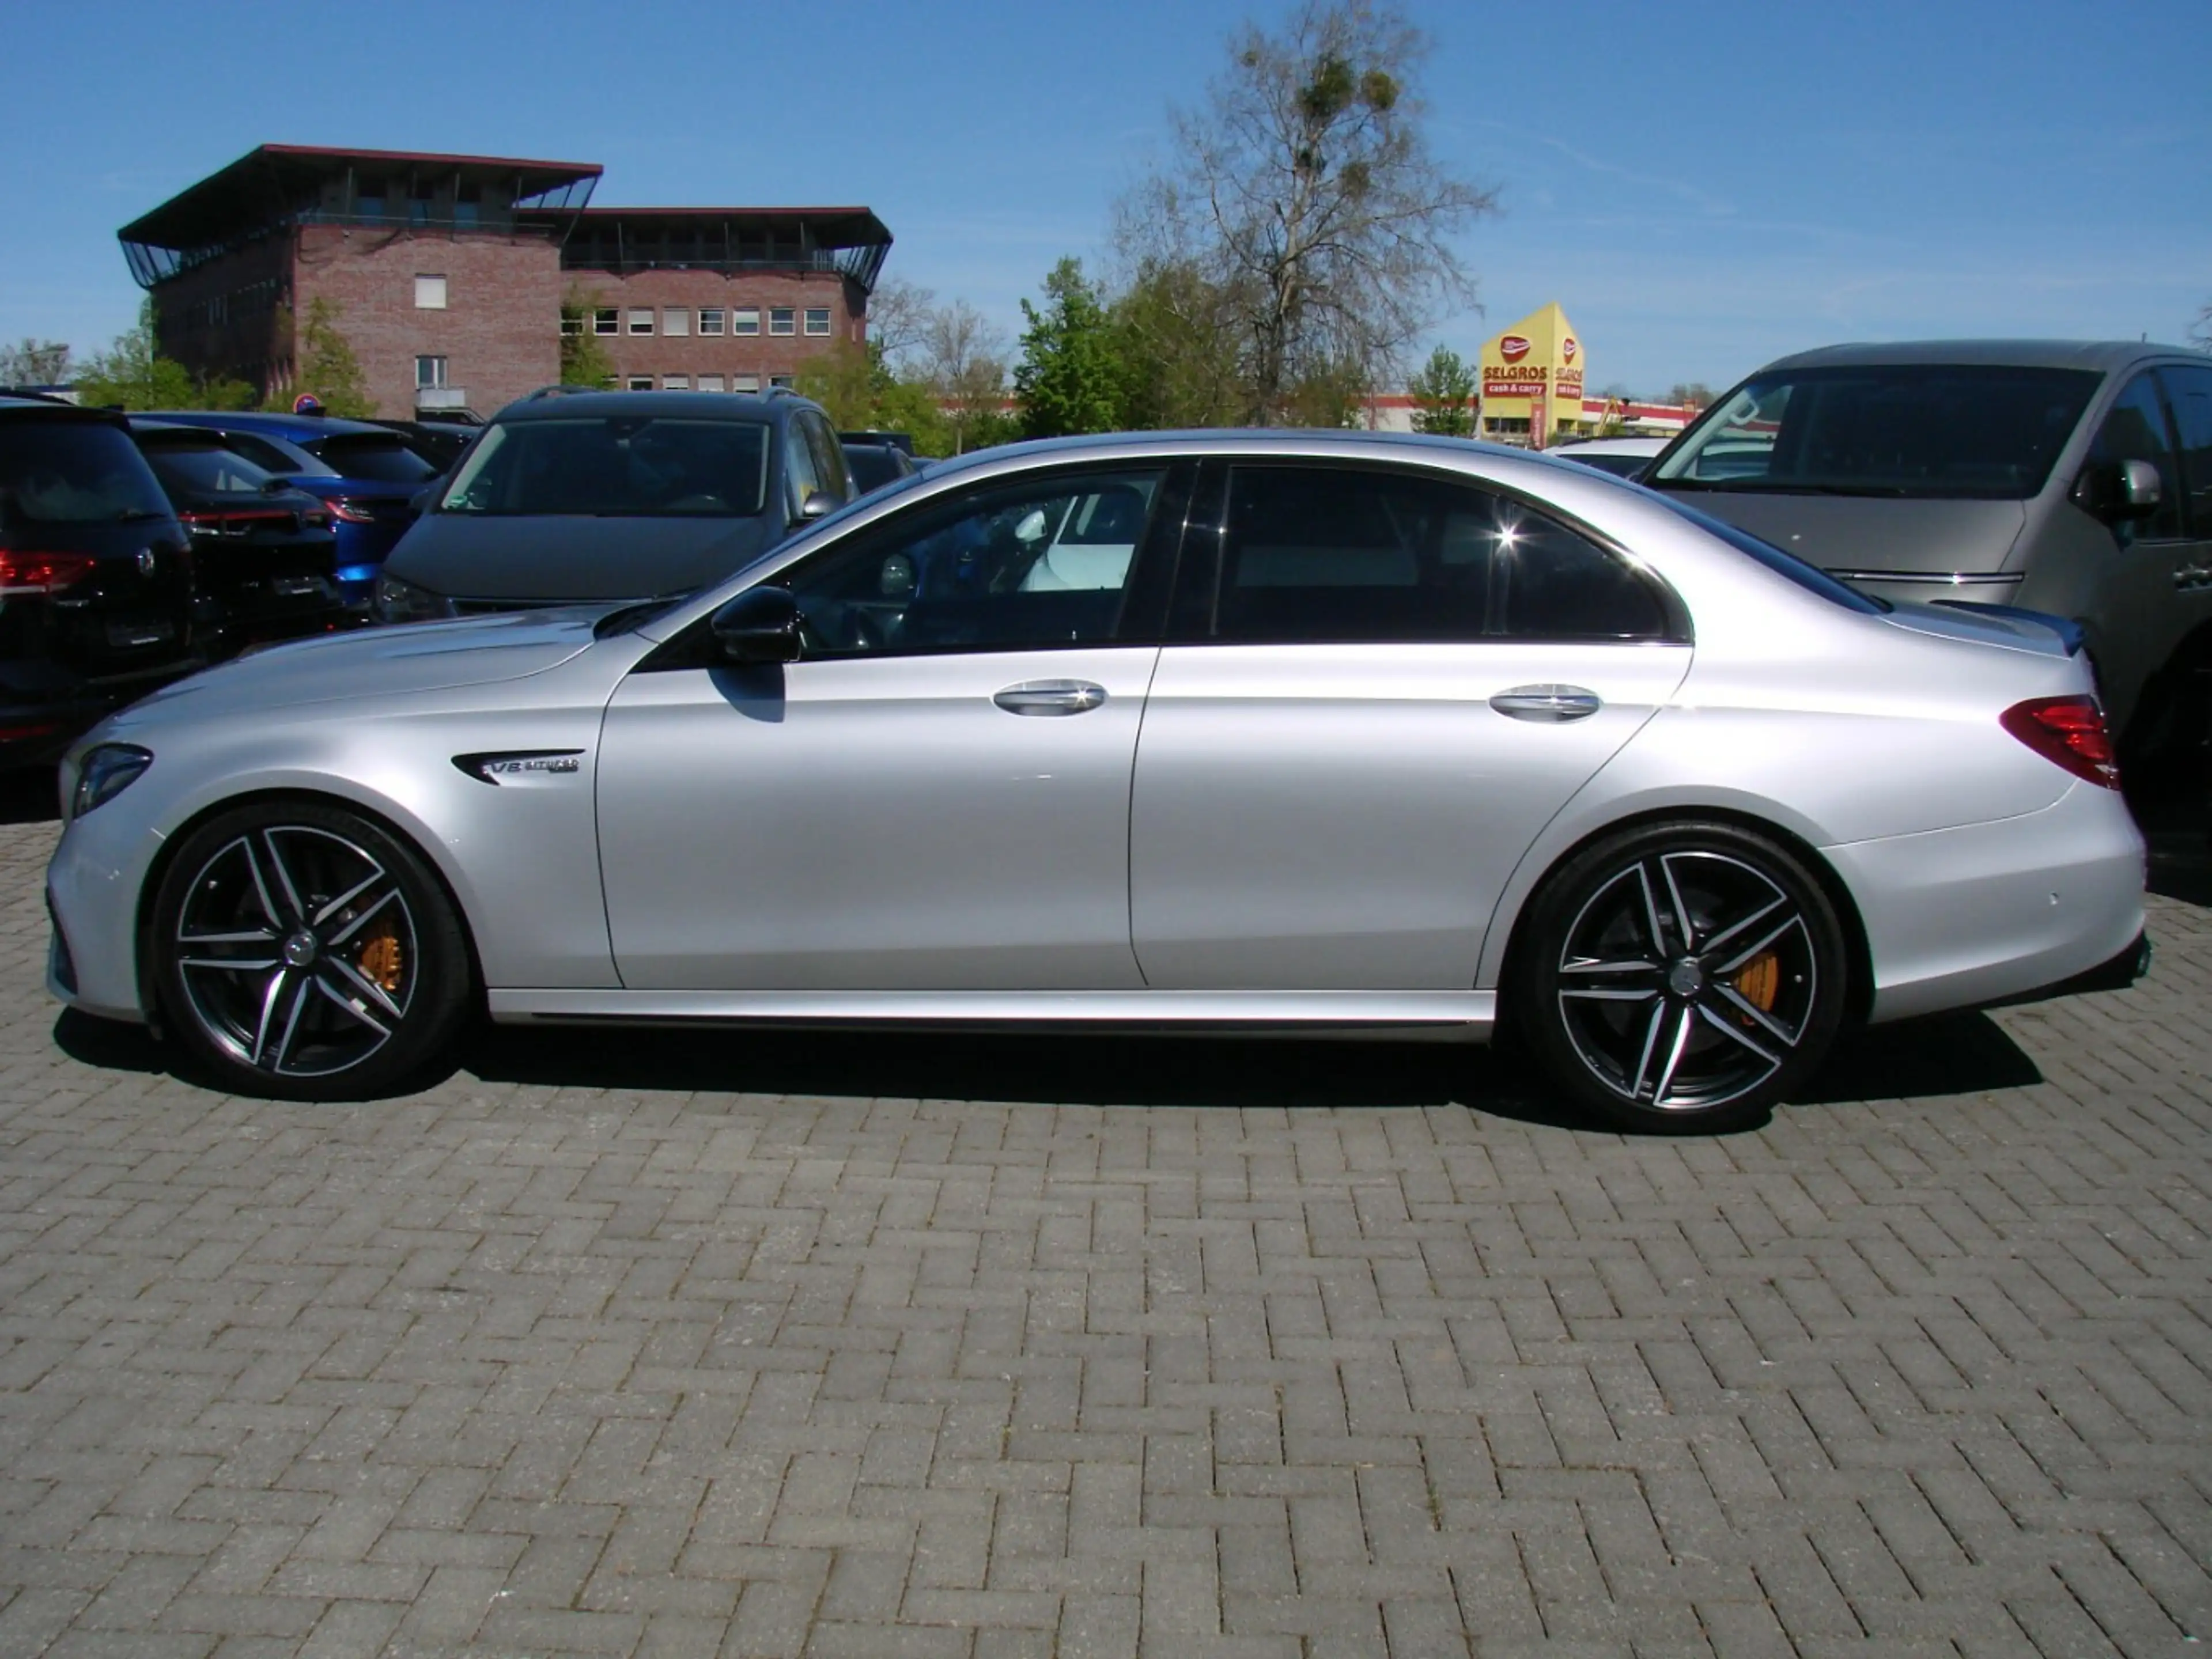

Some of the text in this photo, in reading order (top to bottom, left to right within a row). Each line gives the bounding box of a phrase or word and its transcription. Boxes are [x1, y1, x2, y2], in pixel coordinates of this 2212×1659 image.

[1484, 366, 1546, 380] SELGROS
[1489, 384, 1543, 394] cash & carry
[490, 763, 521, 772] V8
